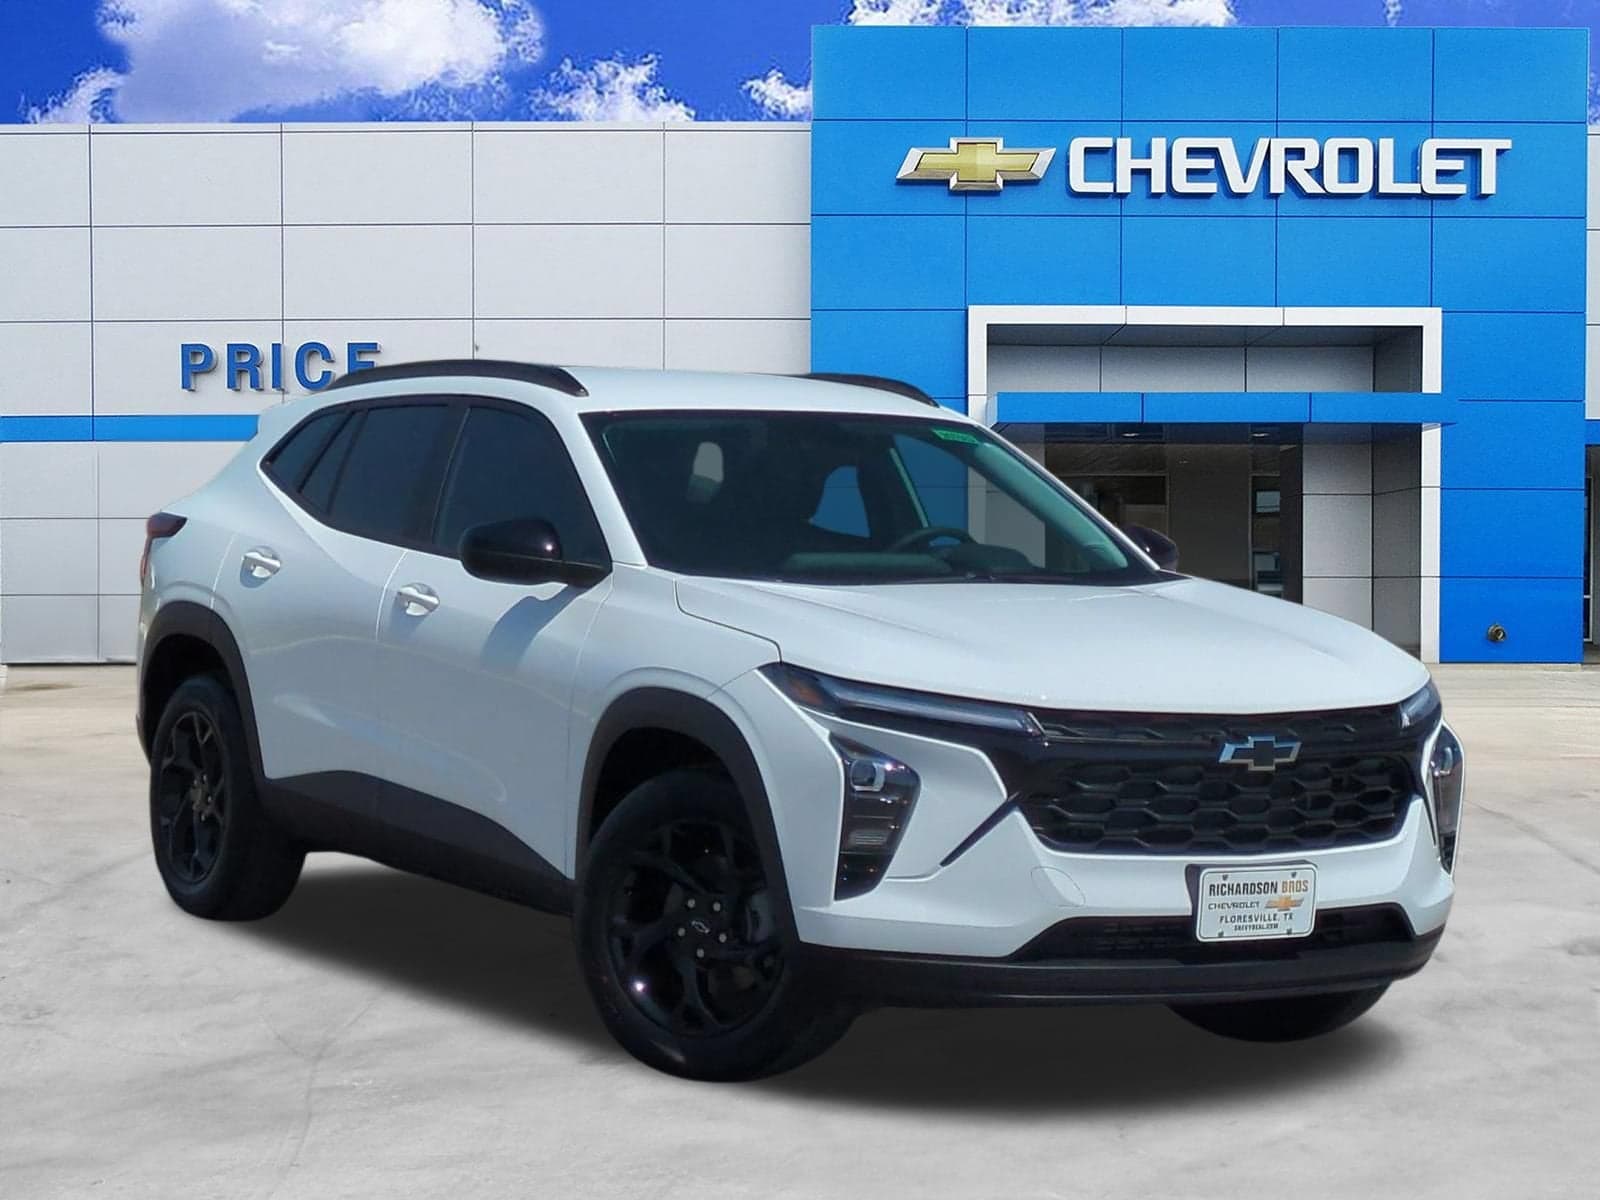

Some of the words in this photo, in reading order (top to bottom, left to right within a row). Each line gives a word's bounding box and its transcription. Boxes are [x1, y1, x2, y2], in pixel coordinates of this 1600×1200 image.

[1069, 137, 1512, 195] CHEVROLET
[1209, 881, 1278, 897] RICHARDSON
[1281, 880, 1309, 893] BROS
[1208, 901, 1260, 910] CHEVROLET
[1283, 912, 1294, 921] TX
